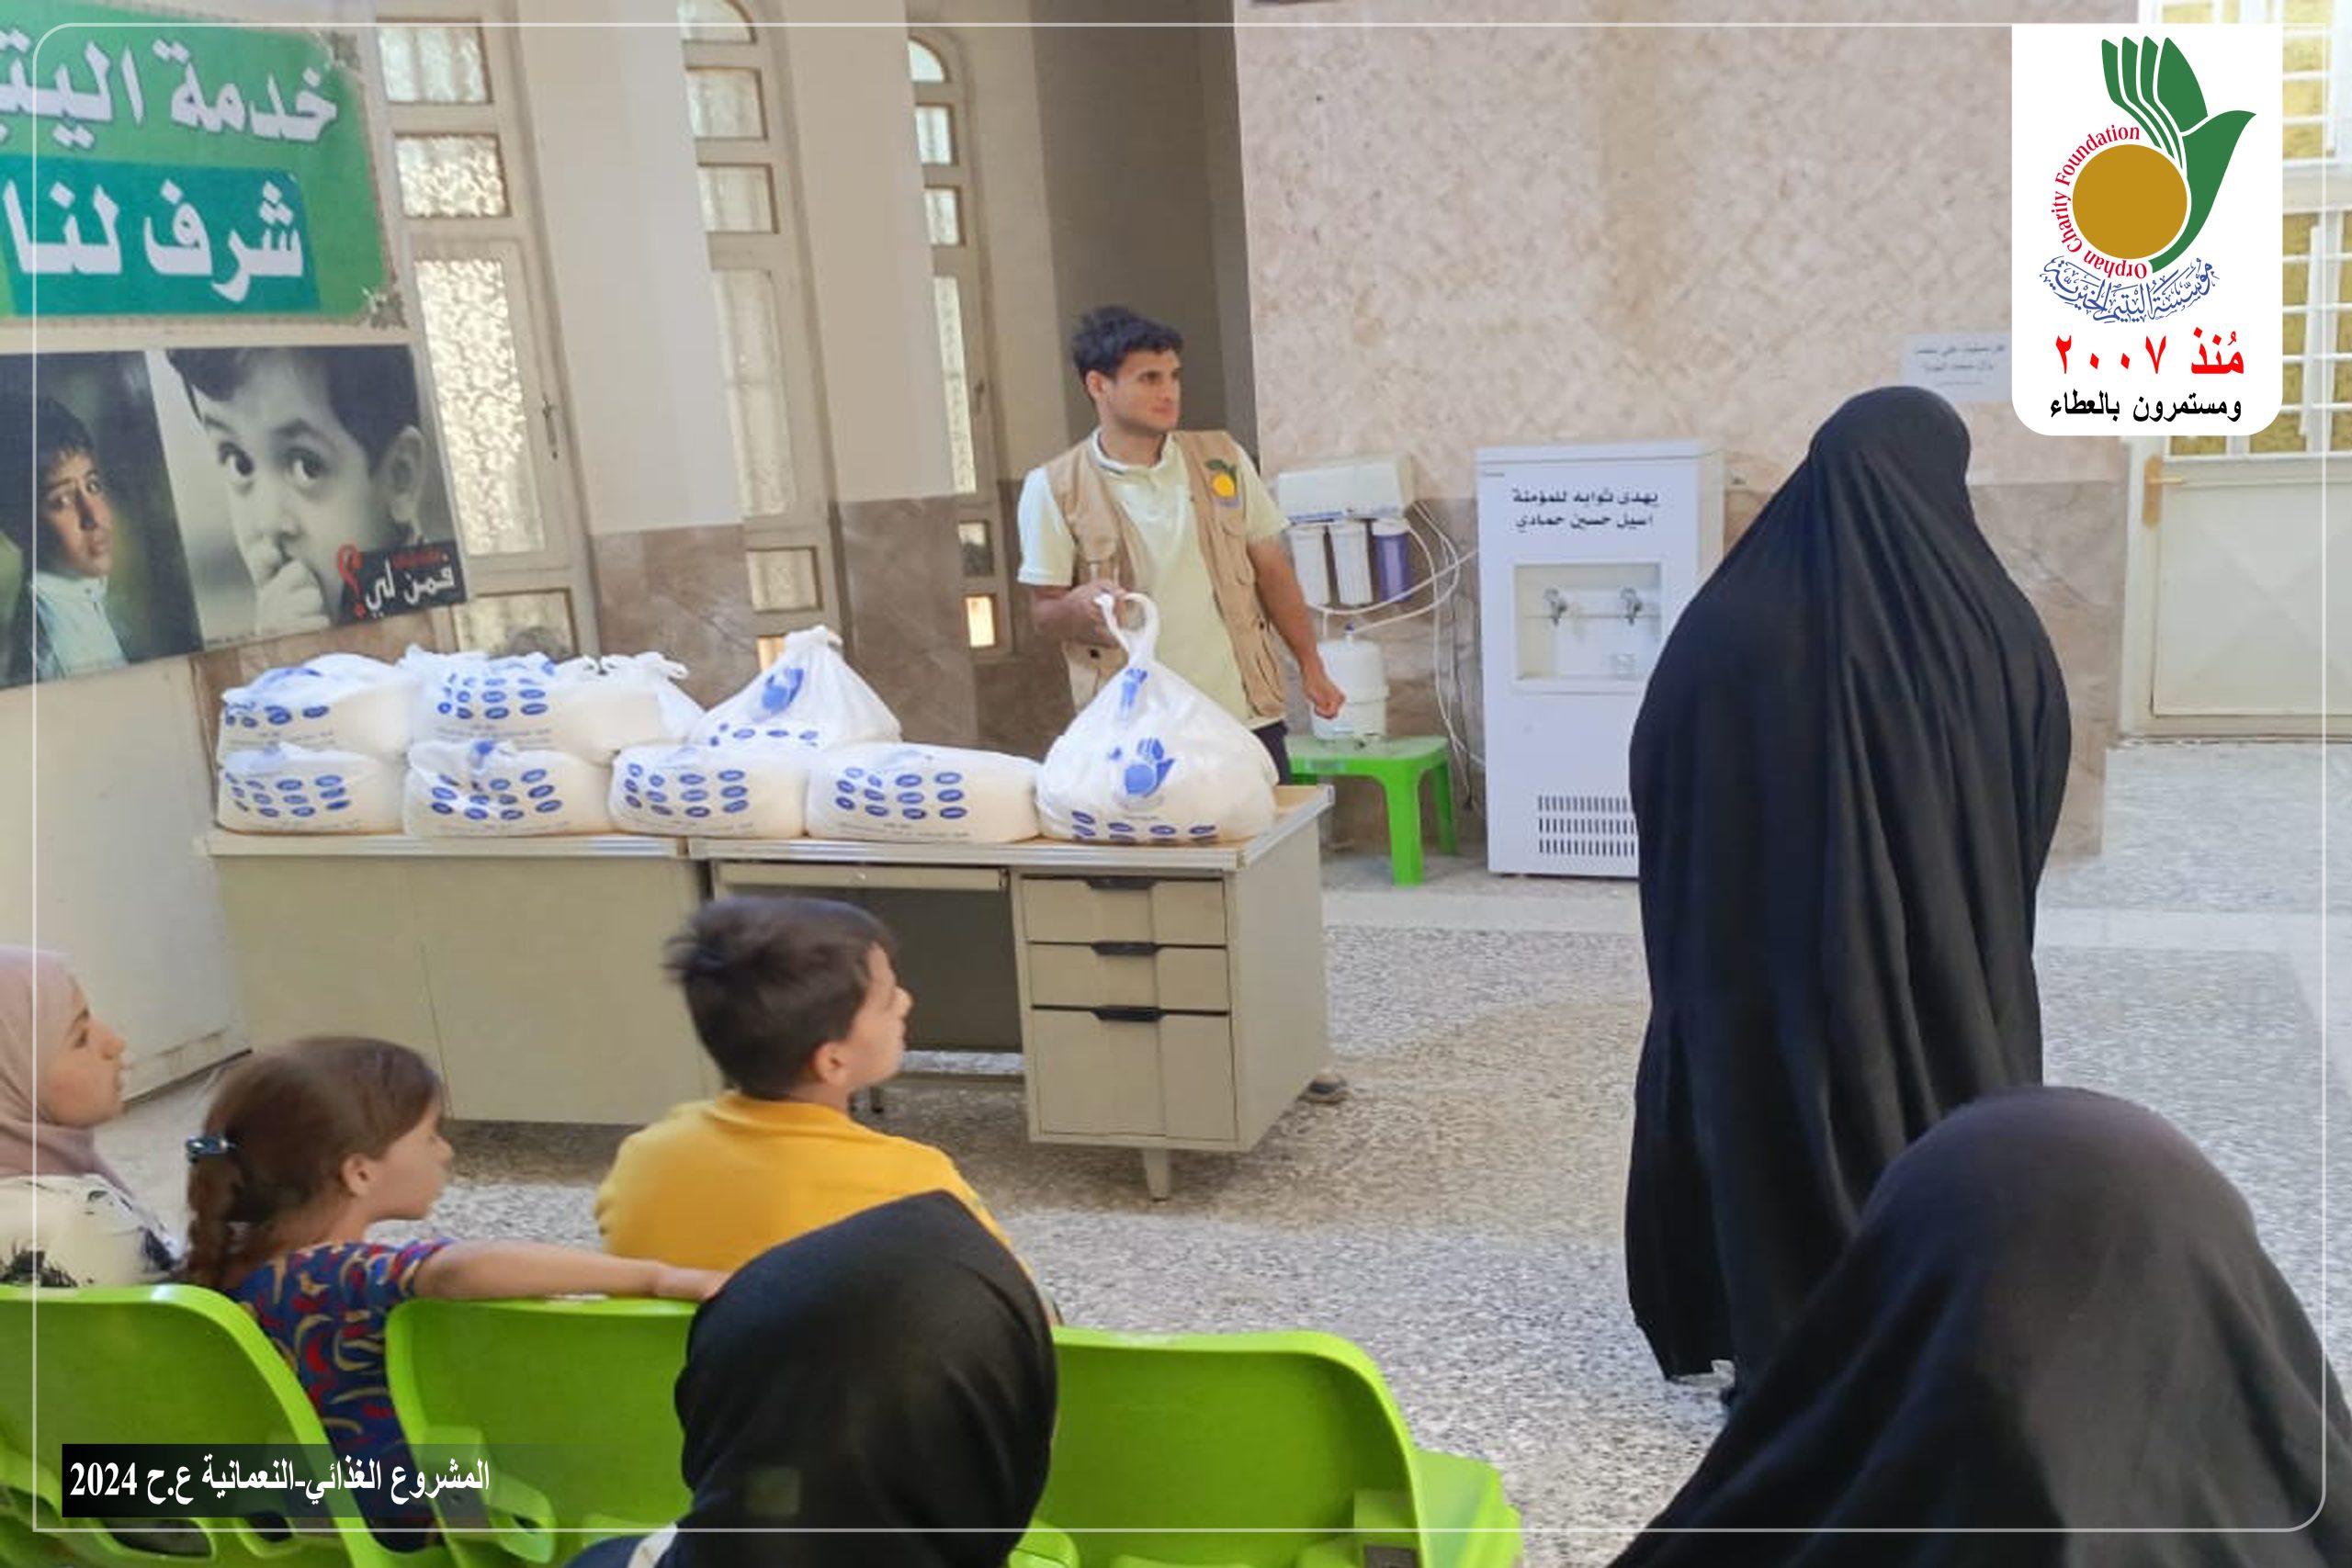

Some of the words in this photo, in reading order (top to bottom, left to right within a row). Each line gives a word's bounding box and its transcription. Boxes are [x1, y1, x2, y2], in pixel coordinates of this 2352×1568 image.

[0, 28, 144, 149] اليت
[152, 38, 338, 142] خدمة
[3, 179, 122, 274] لنا
[143, 178, 304, 303] شرف
[1570, 513, 1611, 530] حسين
[403, 553, 455, 605] فمن
